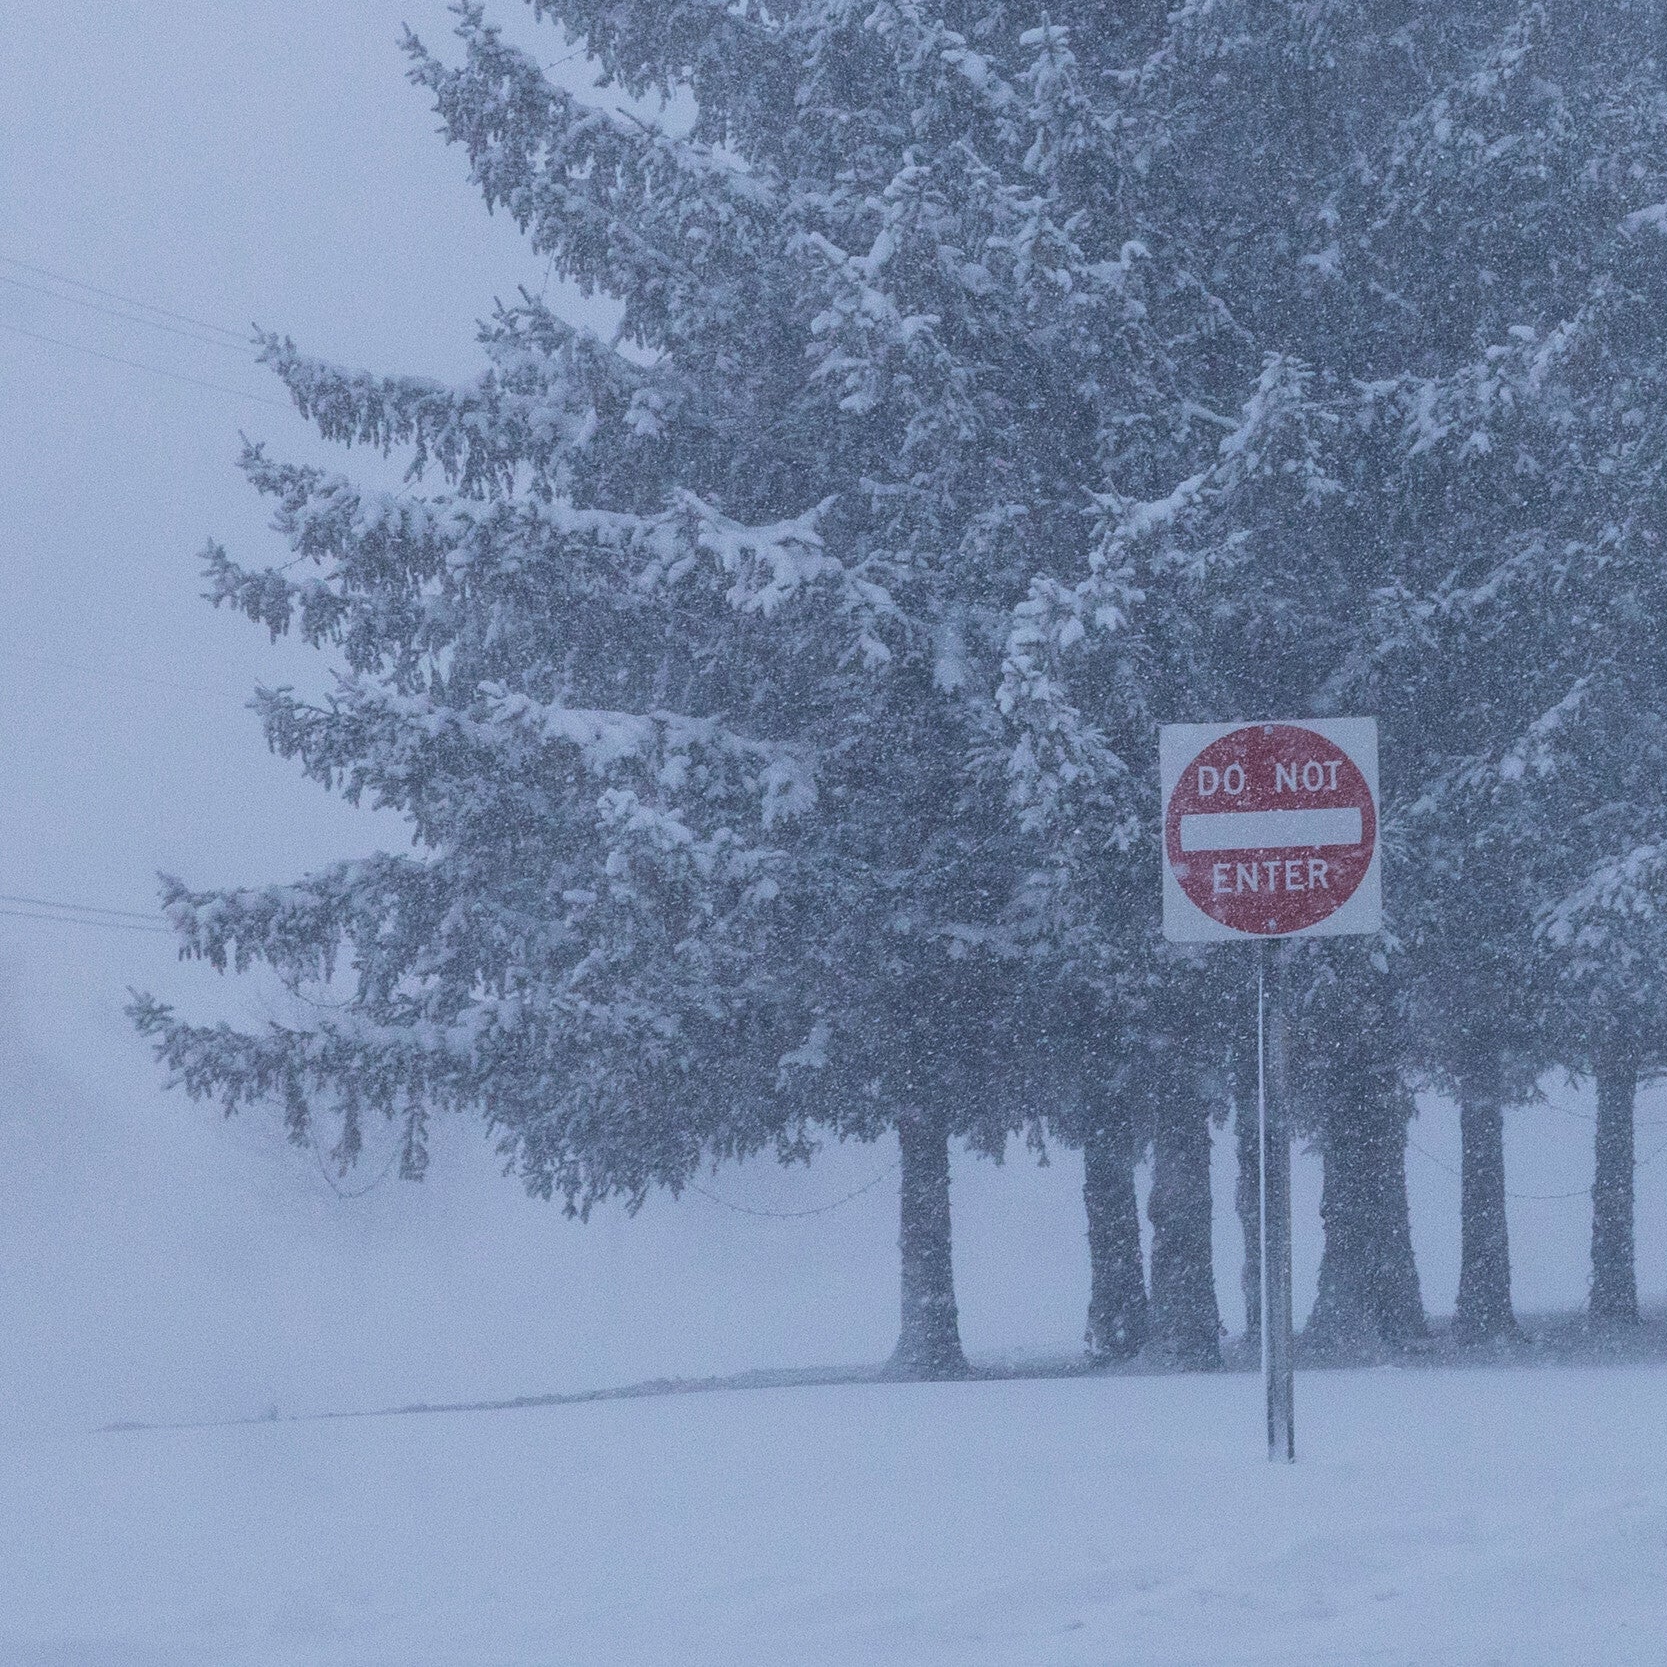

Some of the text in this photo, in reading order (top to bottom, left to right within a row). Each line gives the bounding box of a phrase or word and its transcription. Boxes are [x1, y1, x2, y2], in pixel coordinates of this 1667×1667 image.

[1198, 759, 1342, 797] DO NOT
[1212, 859, 1328, 893] ENTER
